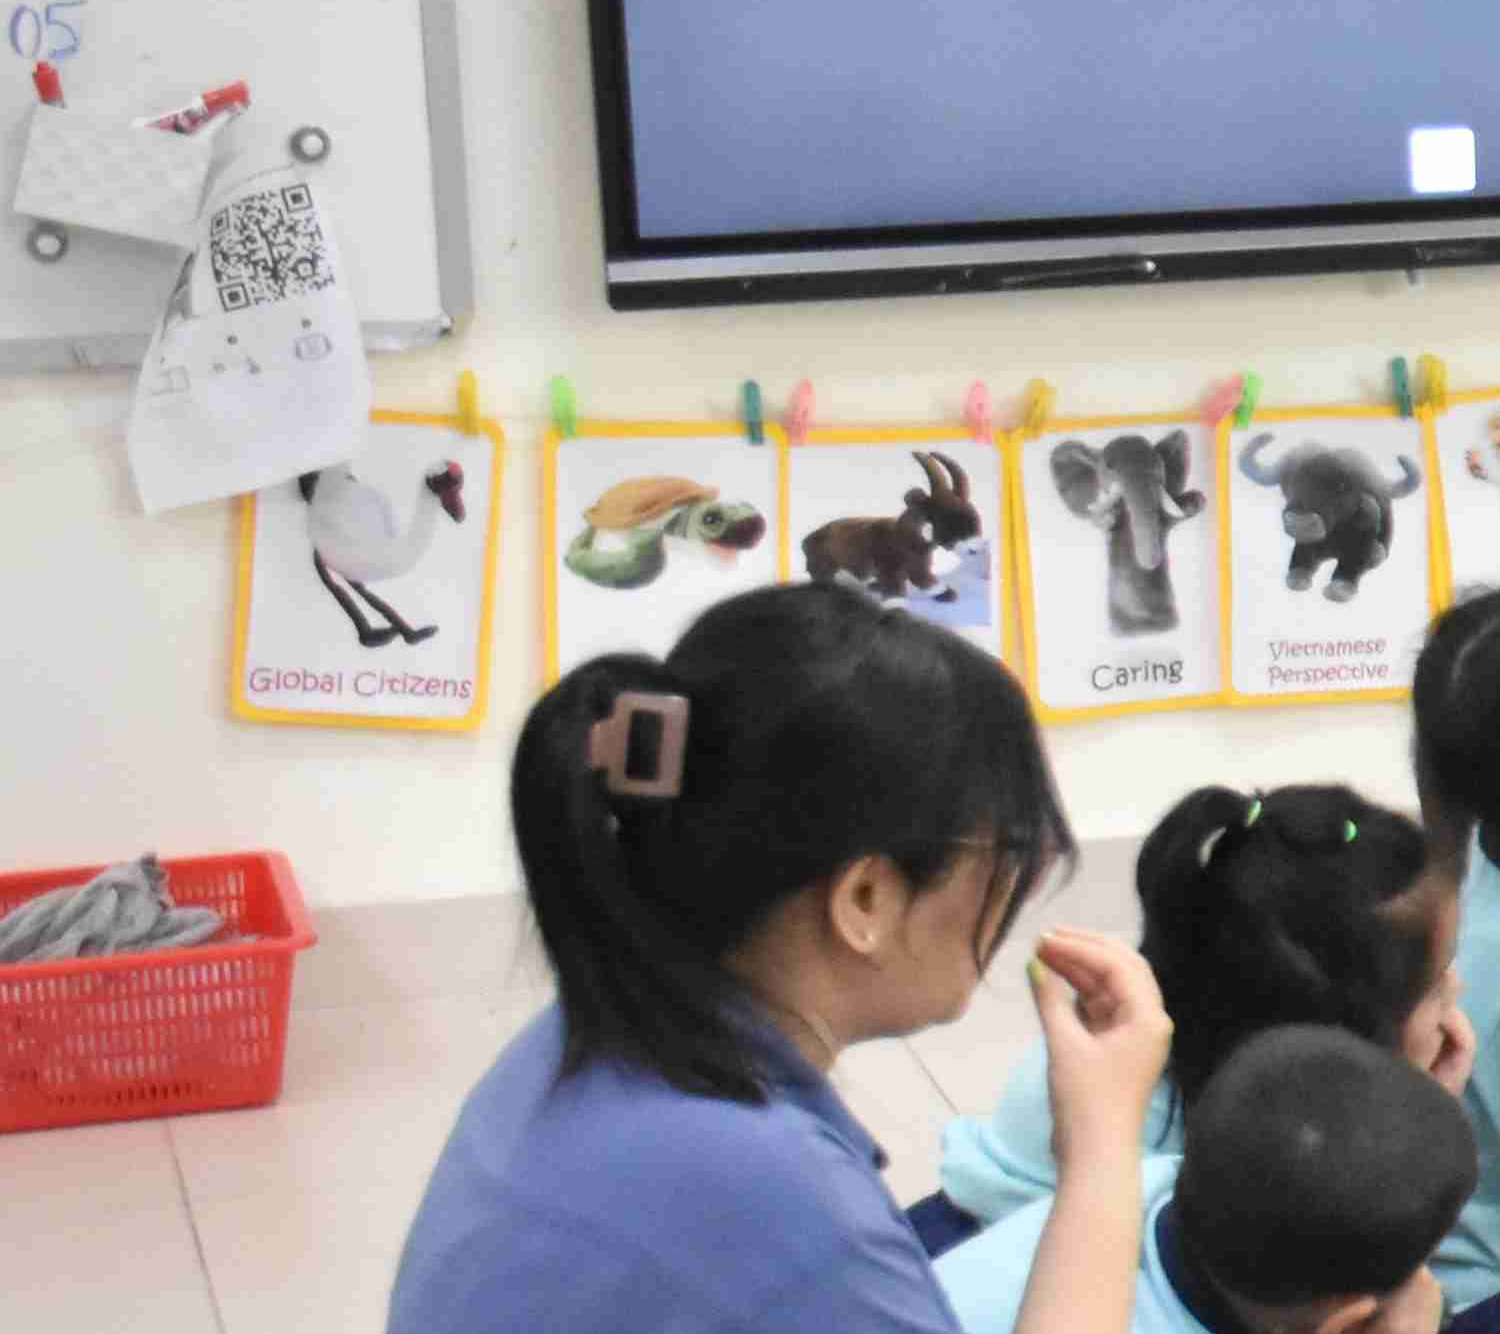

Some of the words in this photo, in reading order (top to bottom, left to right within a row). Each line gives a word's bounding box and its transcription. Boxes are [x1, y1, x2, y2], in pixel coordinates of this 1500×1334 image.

[1268, 637, 1387, 661] Vietnamese
[248, 667, 345, 696] Global
[353, 671, 473, 699] Citizens
[1091, 659, 1185, 693] Caring
[1267, 662, 1390, 686] Perspective
